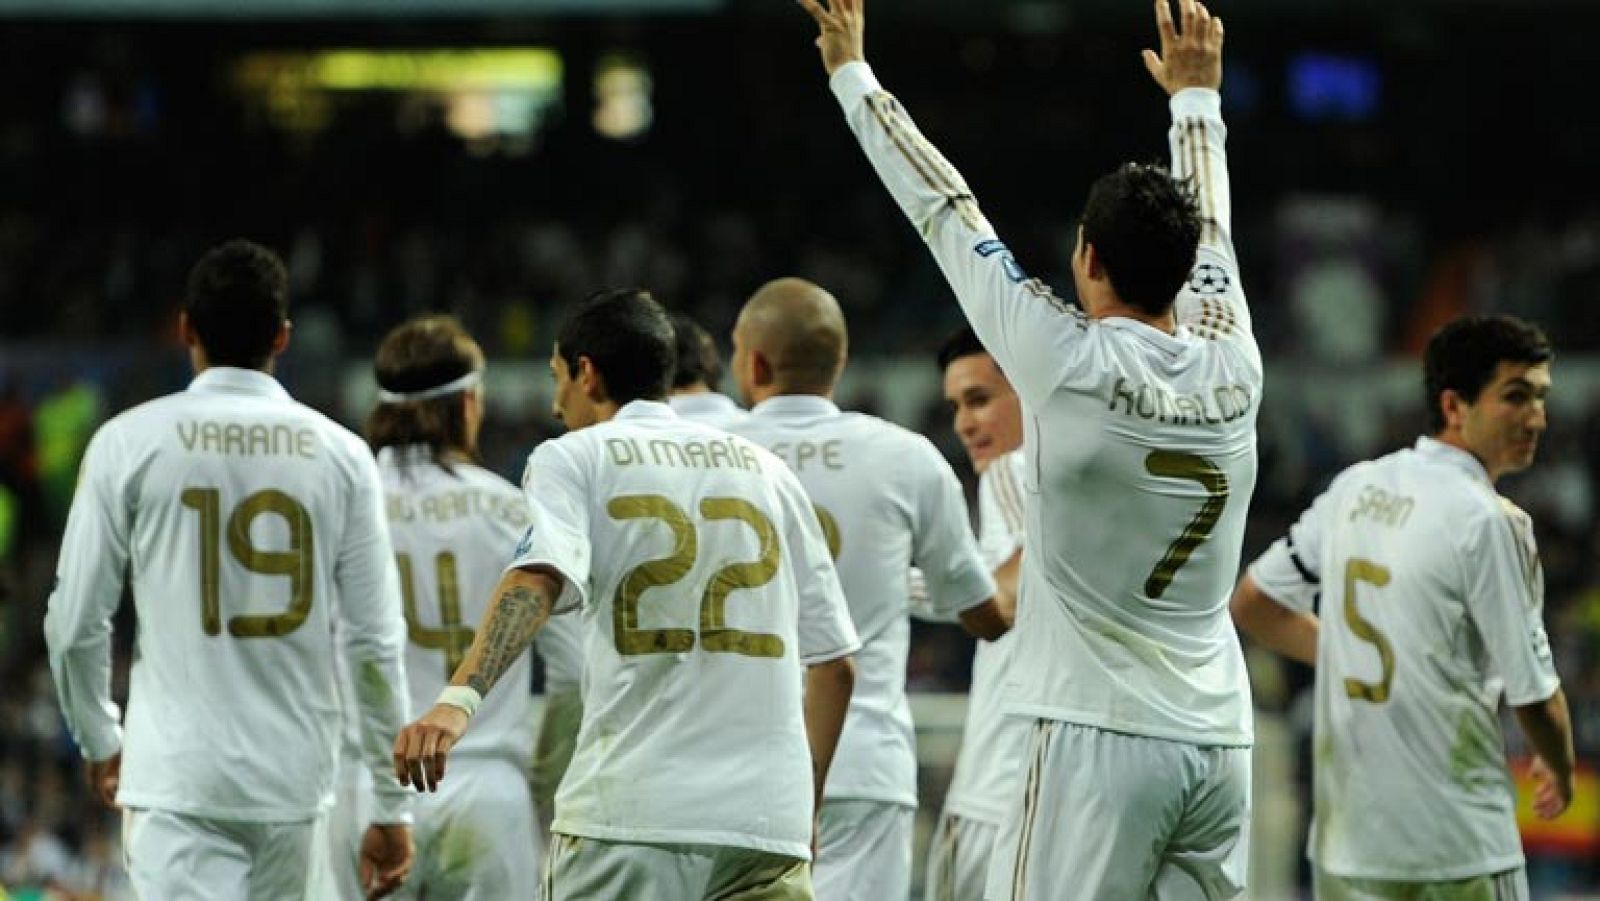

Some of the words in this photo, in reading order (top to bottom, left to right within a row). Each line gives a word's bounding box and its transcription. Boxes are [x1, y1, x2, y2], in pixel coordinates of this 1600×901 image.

[177, 420, 315, 459] VARANE
[605, 438, 645, 467] DI
[770, 439, 844, 471] EPE
[1110, 377, 1250, 424] RONALDO
[180, 487, 314, 638] 19
[606, 494, 786, 658] 22
[1144, 449, 1230, 599] 7
[397, 550, 476, 685] 4
[1344, 558, 1396, 704] 5
